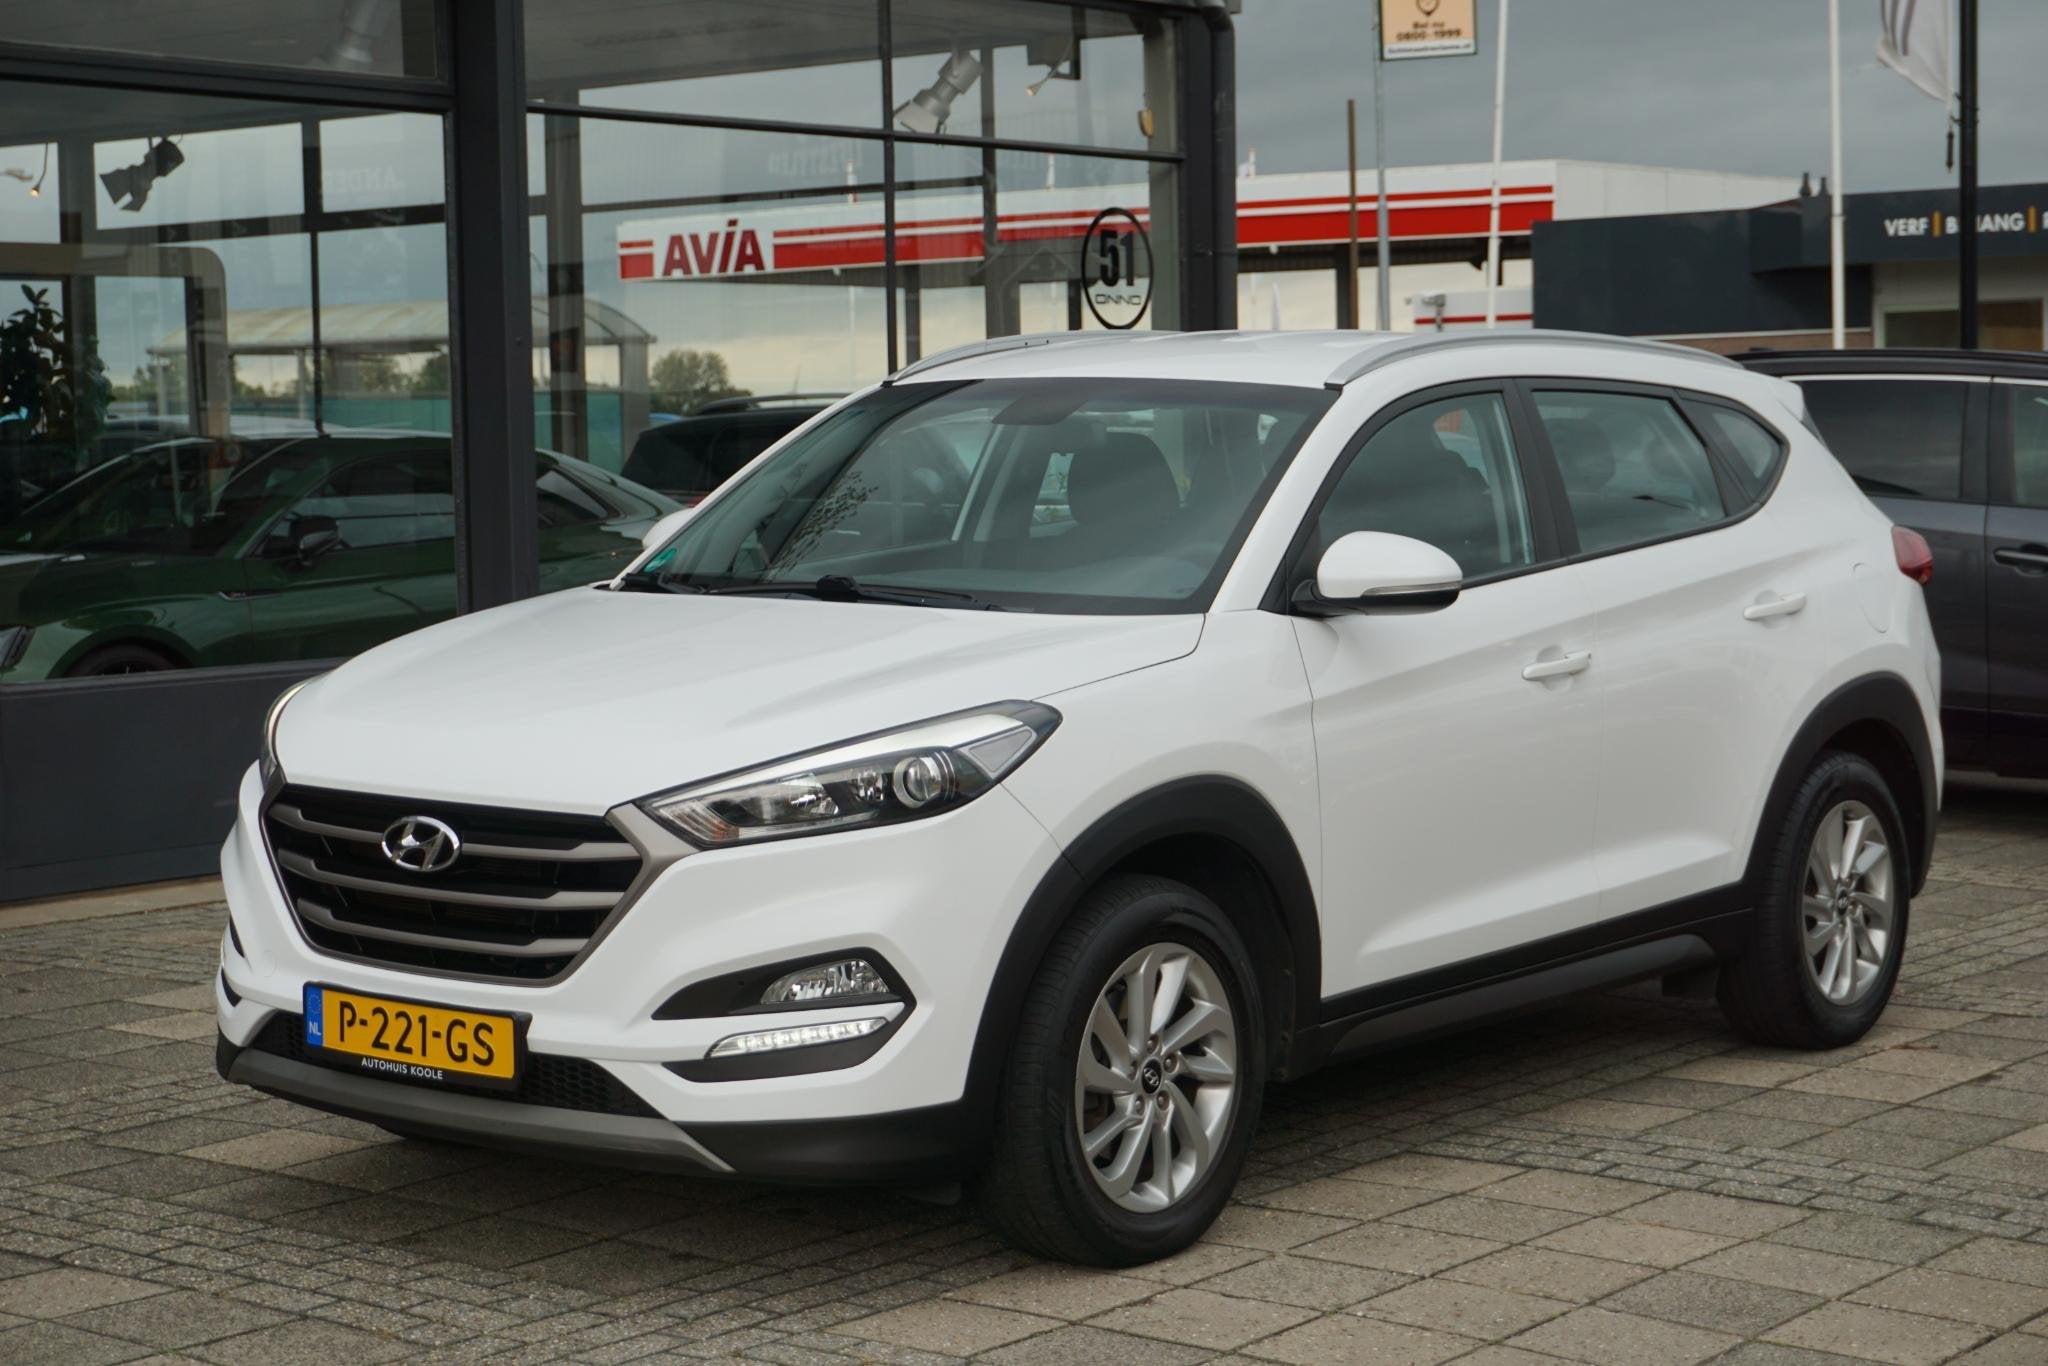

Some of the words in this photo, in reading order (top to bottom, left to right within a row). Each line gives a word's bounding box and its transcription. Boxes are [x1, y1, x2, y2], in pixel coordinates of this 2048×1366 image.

[1884, 216, 1929, 237] VERF
[662, 218, 765, 276] AVIA
[1100, 230, 1134, 288] 51
[308, 1020, 322, 1036] NL
[339, 1000, 495, 1067] P-221-GS
[361, 1057, 408, 1074] AUTOHUIS
[410, 1066, 444, 1080] KOOLE
